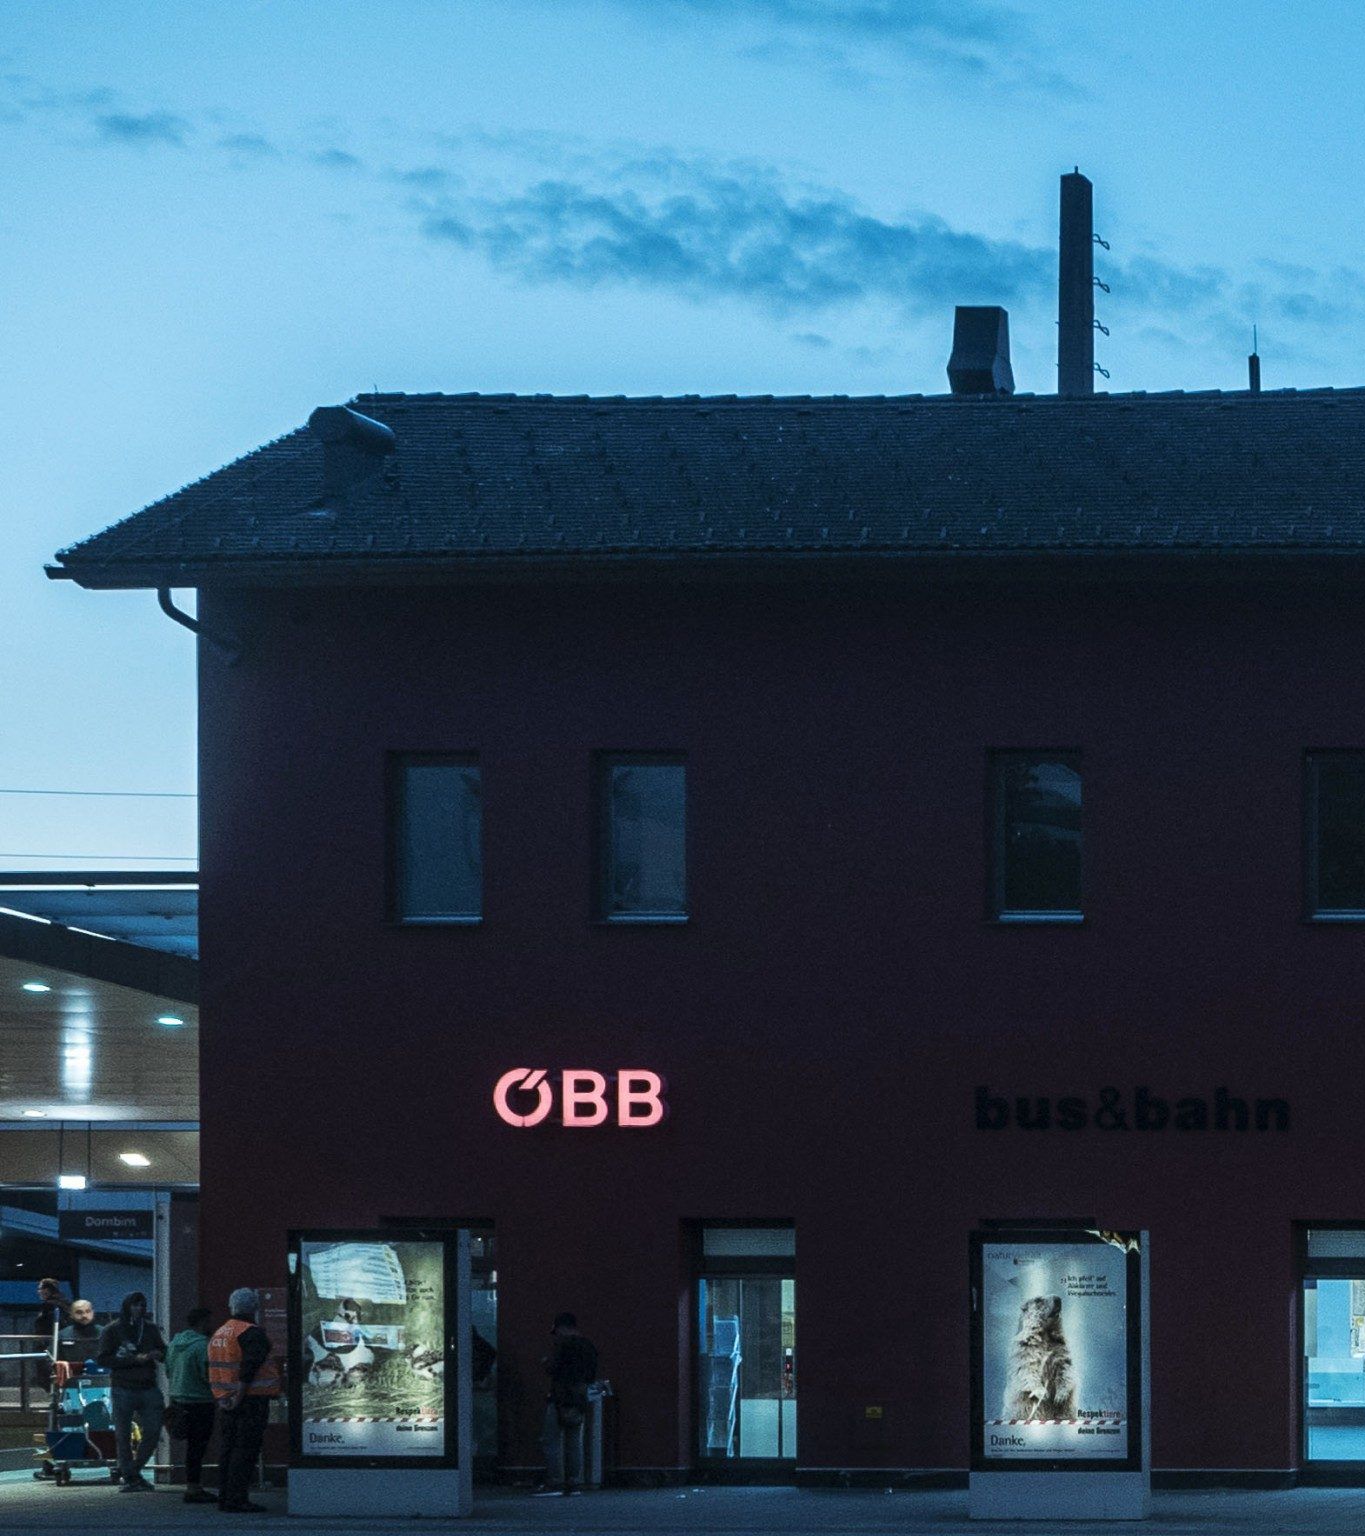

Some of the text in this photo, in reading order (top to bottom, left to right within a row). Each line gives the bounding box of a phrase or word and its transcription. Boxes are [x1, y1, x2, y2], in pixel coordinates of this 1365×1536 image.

[493, 1068, 663, 1127] ÖBB
[975, 1086, 1290, 1131] bus&bahn
[85, 1217, 136, 1227] Dornbirn
